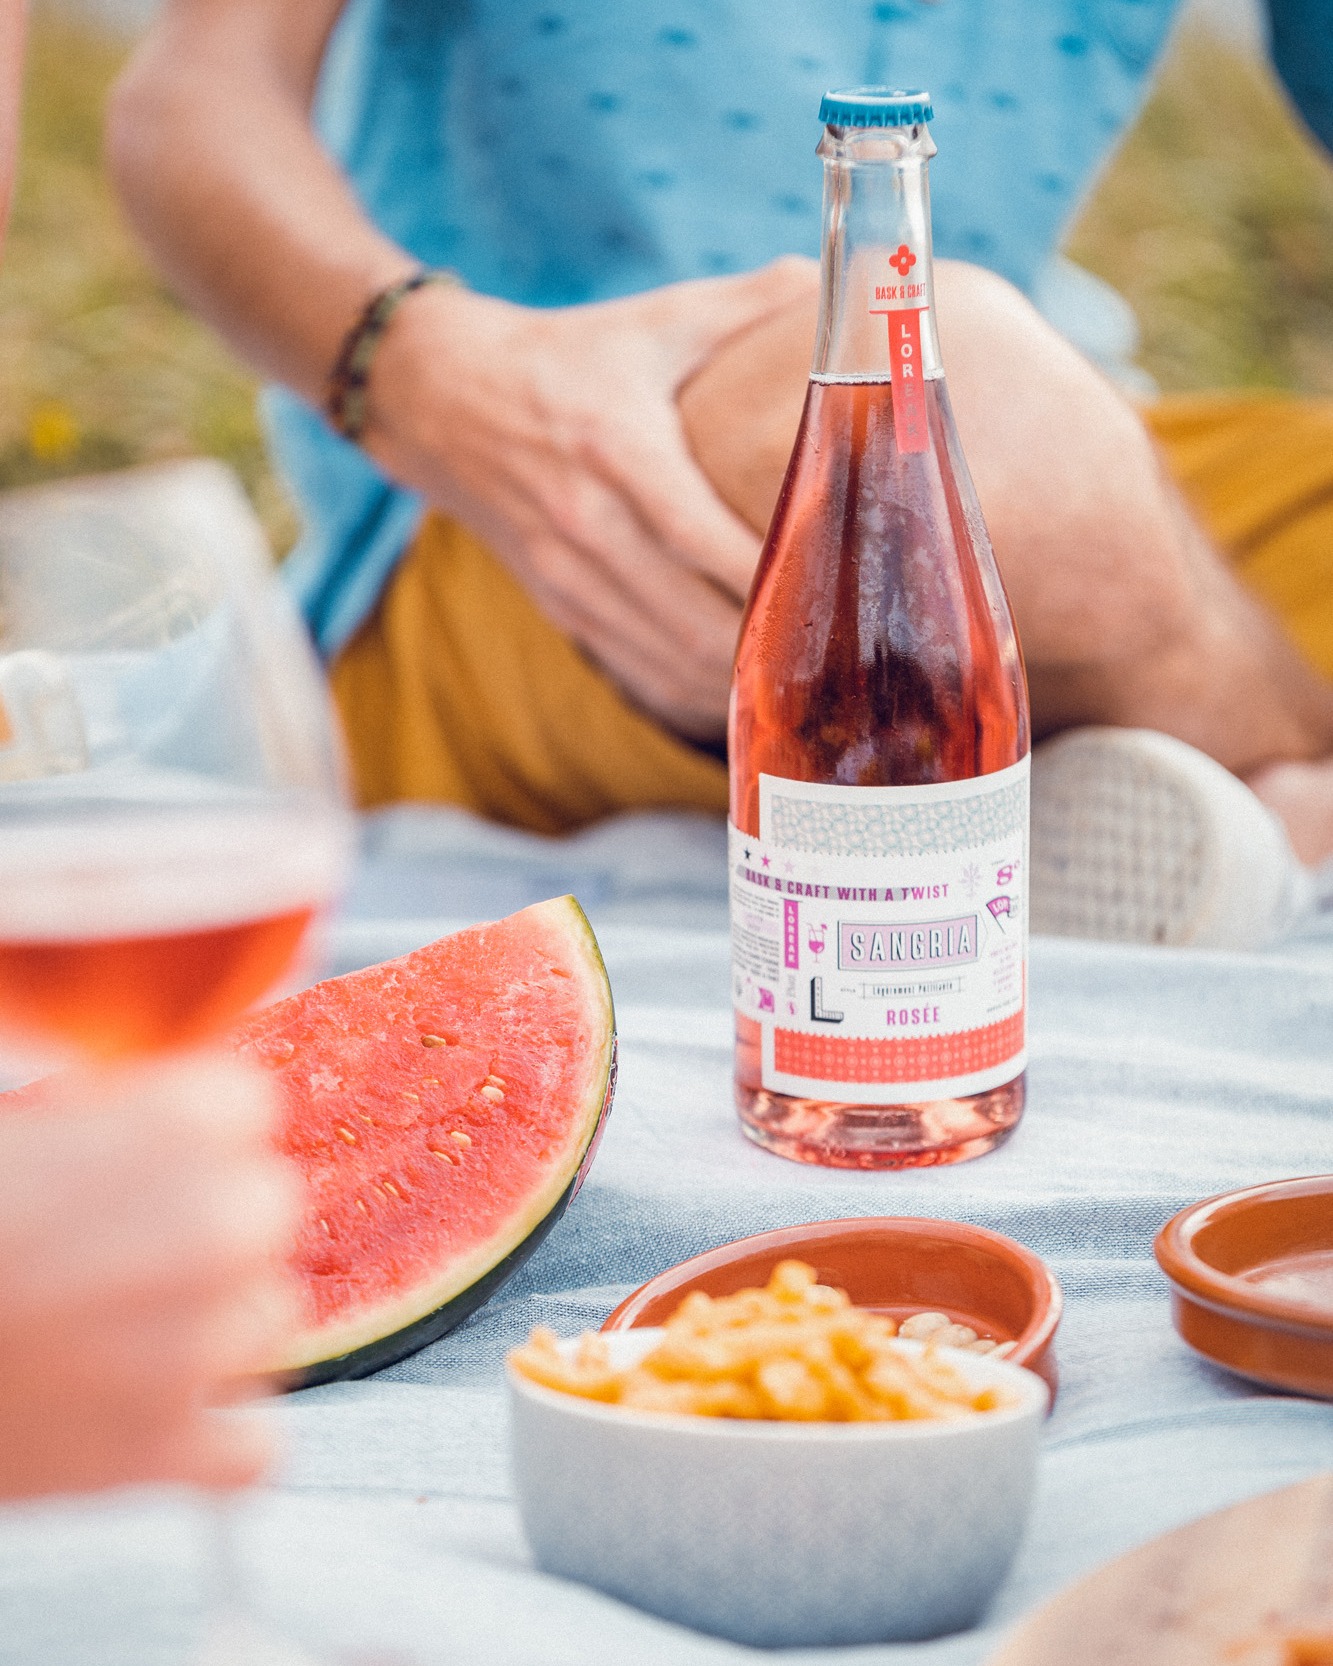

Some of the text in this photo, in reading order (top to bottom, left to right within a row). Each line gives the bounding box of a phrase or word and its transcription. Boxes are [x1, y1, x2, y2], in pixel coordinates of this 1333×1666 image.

[875, 284, 897, 300] BASK
[907, 283, 926, 299] CRAFT
[787, 881, 829, 899] CRAFT
[837, 887, 877, 902] WITH
[884, 888, 893, 901] A
[901, 884, 949, 901] TWIST
[850, 924, 973, 963] SANGRIA
[886, 1002, 940, 1027] ROSÉE
